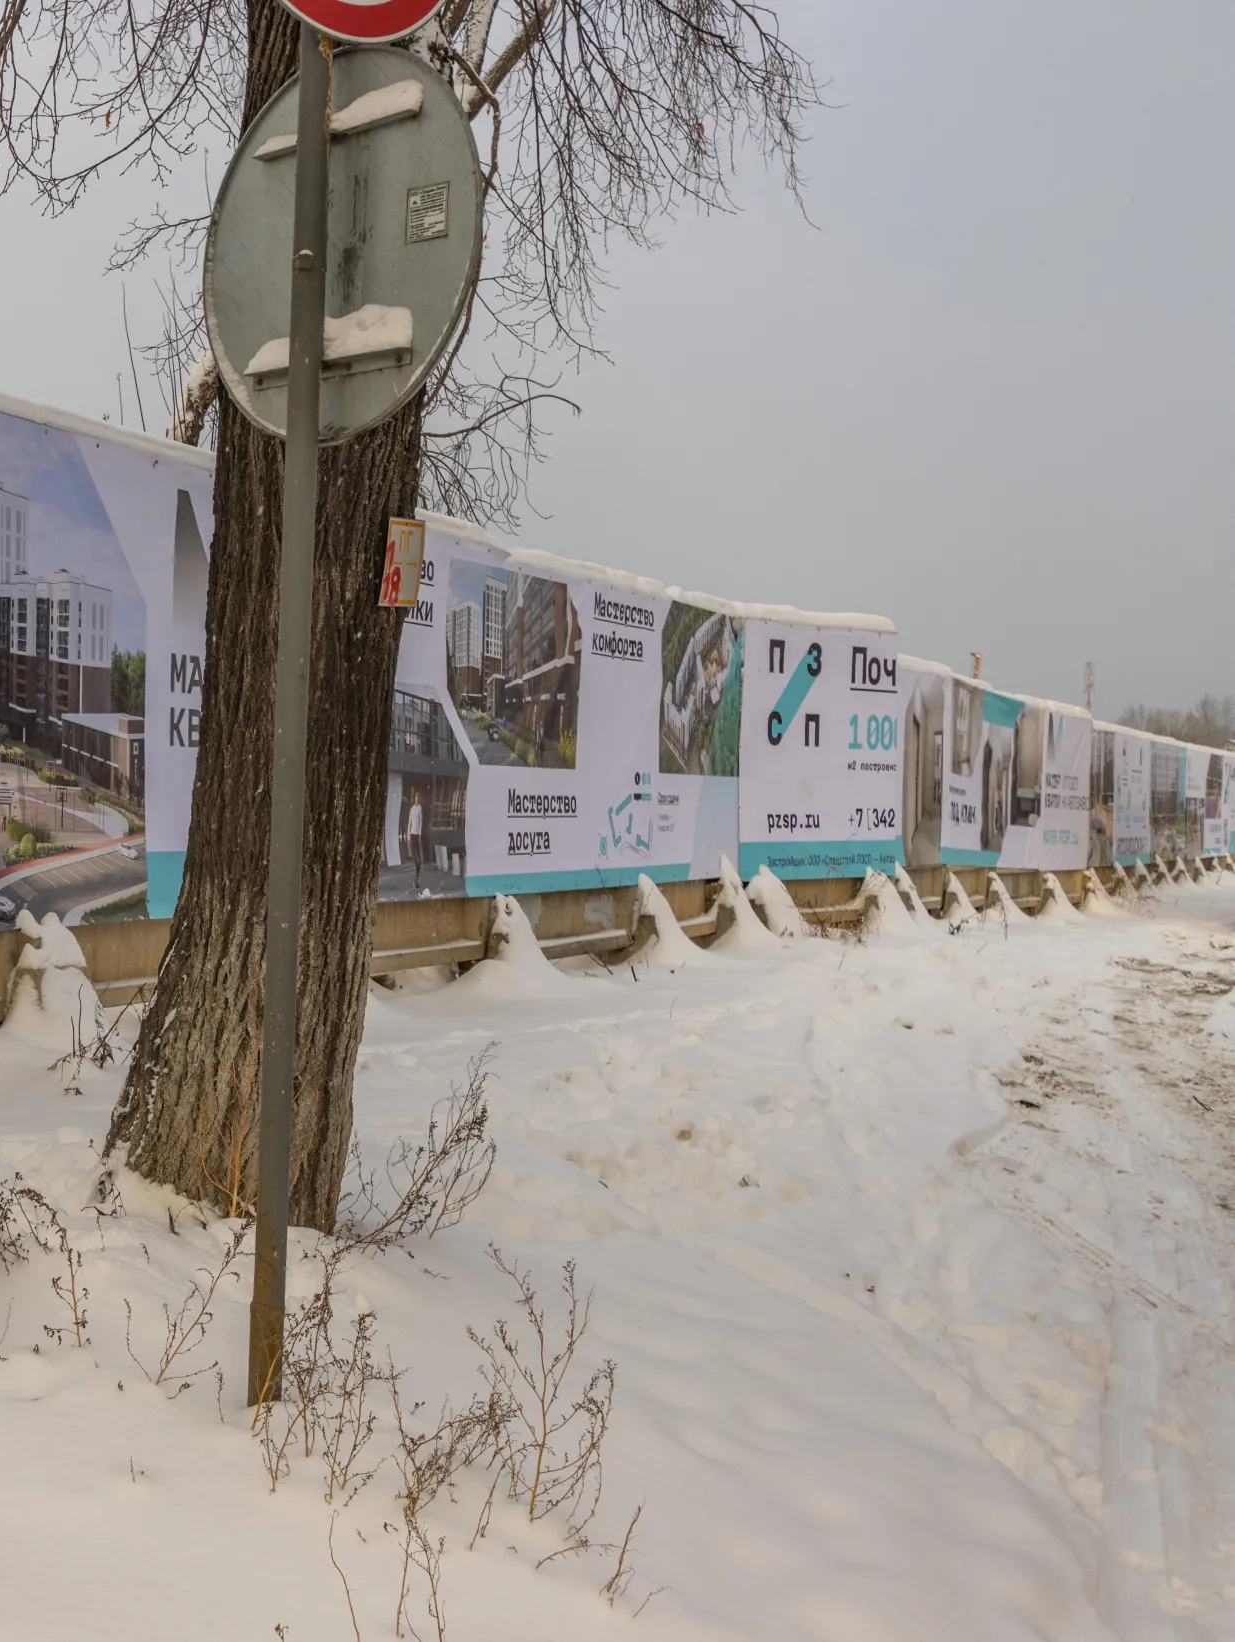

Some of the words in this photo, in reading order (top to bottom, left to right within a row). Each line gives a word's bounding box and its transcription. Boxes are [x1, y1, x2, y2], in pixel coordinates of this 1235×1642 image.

[421, 560, 434, 581] ВО
[594, 592, 655, 627] Мастерство
[592, 631, 644, 660] комфорта
[769, 639, 785, 673] П
[171, 653, 203, 694] МА
[170, 707, 201, 747] КВ
[768, 711, 782, 745] С
[805, 714, 820, 747] П
[849, 714, 897, 750] 100
[508, 789, 577, 818] Мастерство
[848, 809, 863, 828] +7
[767, 813, 820, 833] pzsp.ru
[508, 831, 550, 854] досуга
